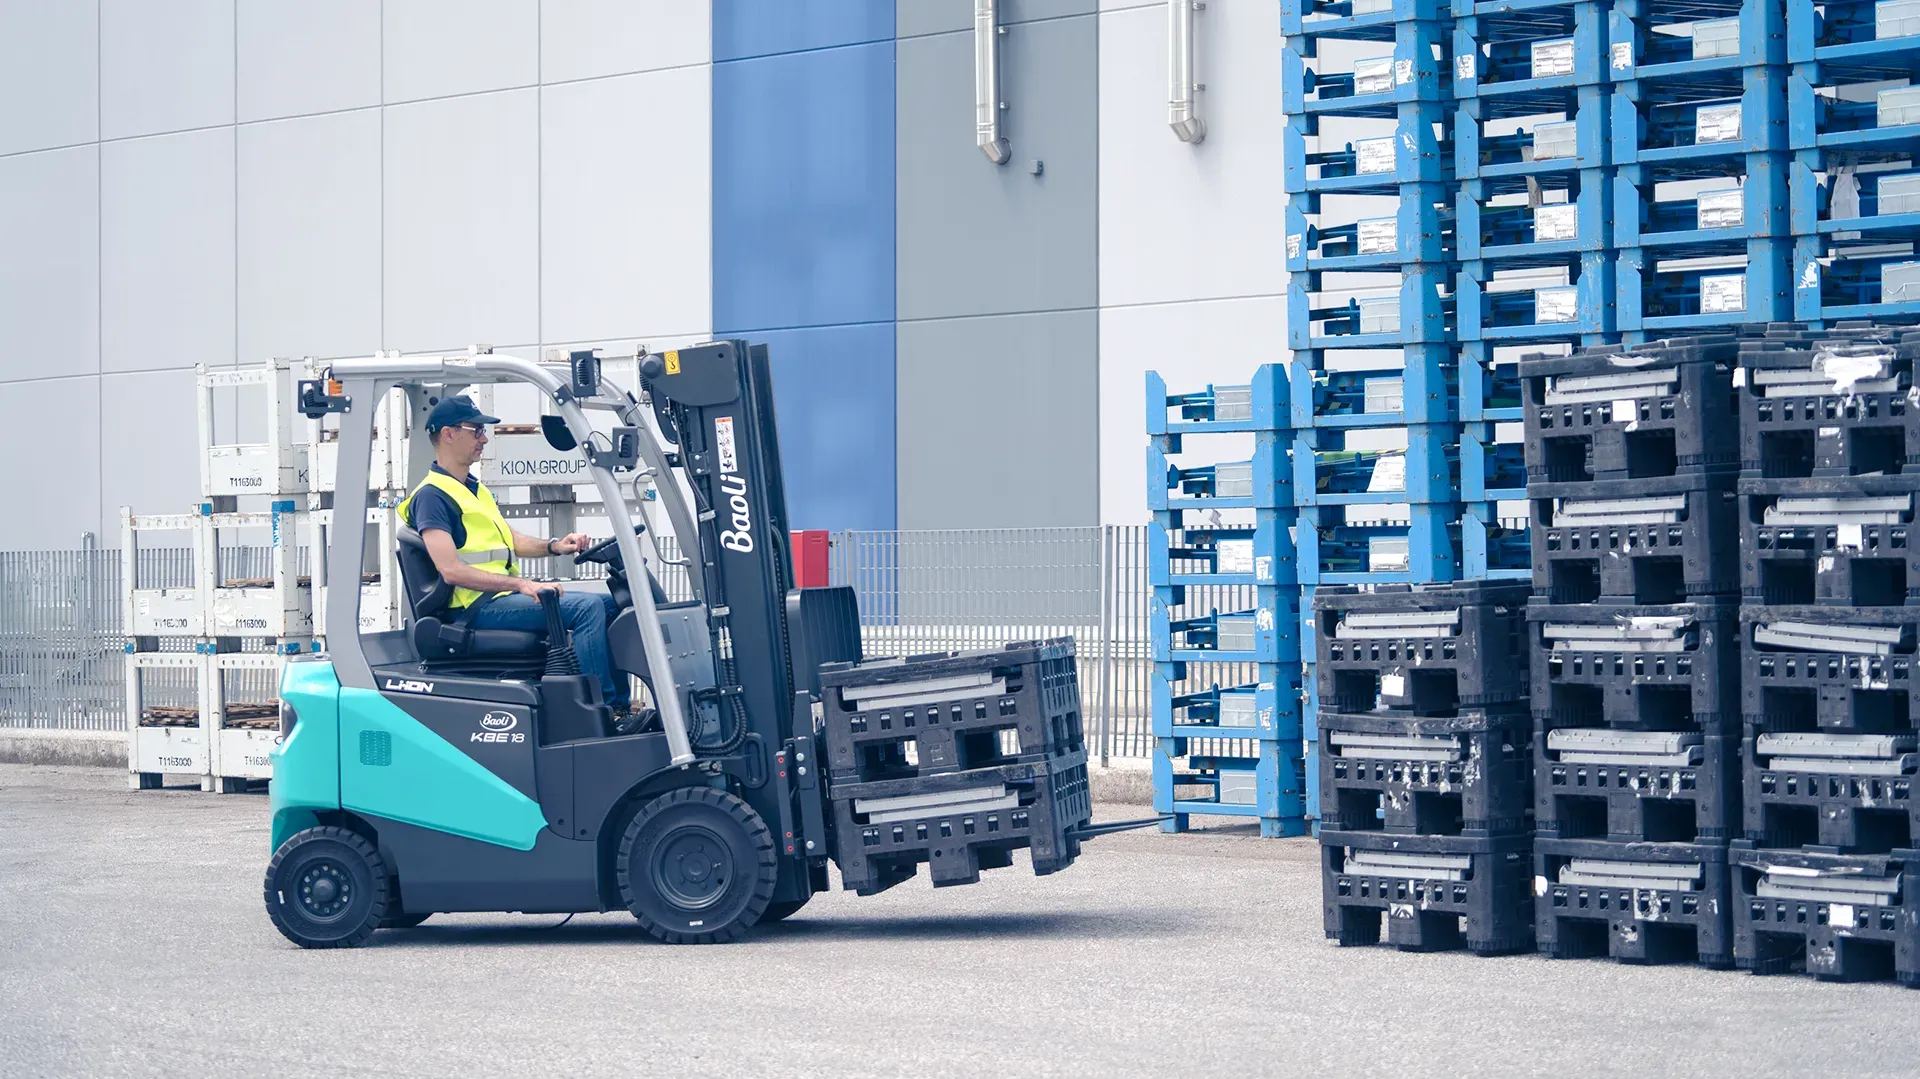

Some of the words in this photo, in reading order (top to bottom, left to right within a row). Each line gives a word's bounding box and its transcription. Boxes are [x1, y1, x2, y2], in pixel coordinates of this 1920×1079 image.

[501, 460, 536, 474] KION
[539, 459, 587, 474] GROUP
[719, 474, 754, 553] Baoli
[482, 713, 510, 726] Baoli
[470, 732, 508, 743] KBE
[511, 733, 525, 743] 18
